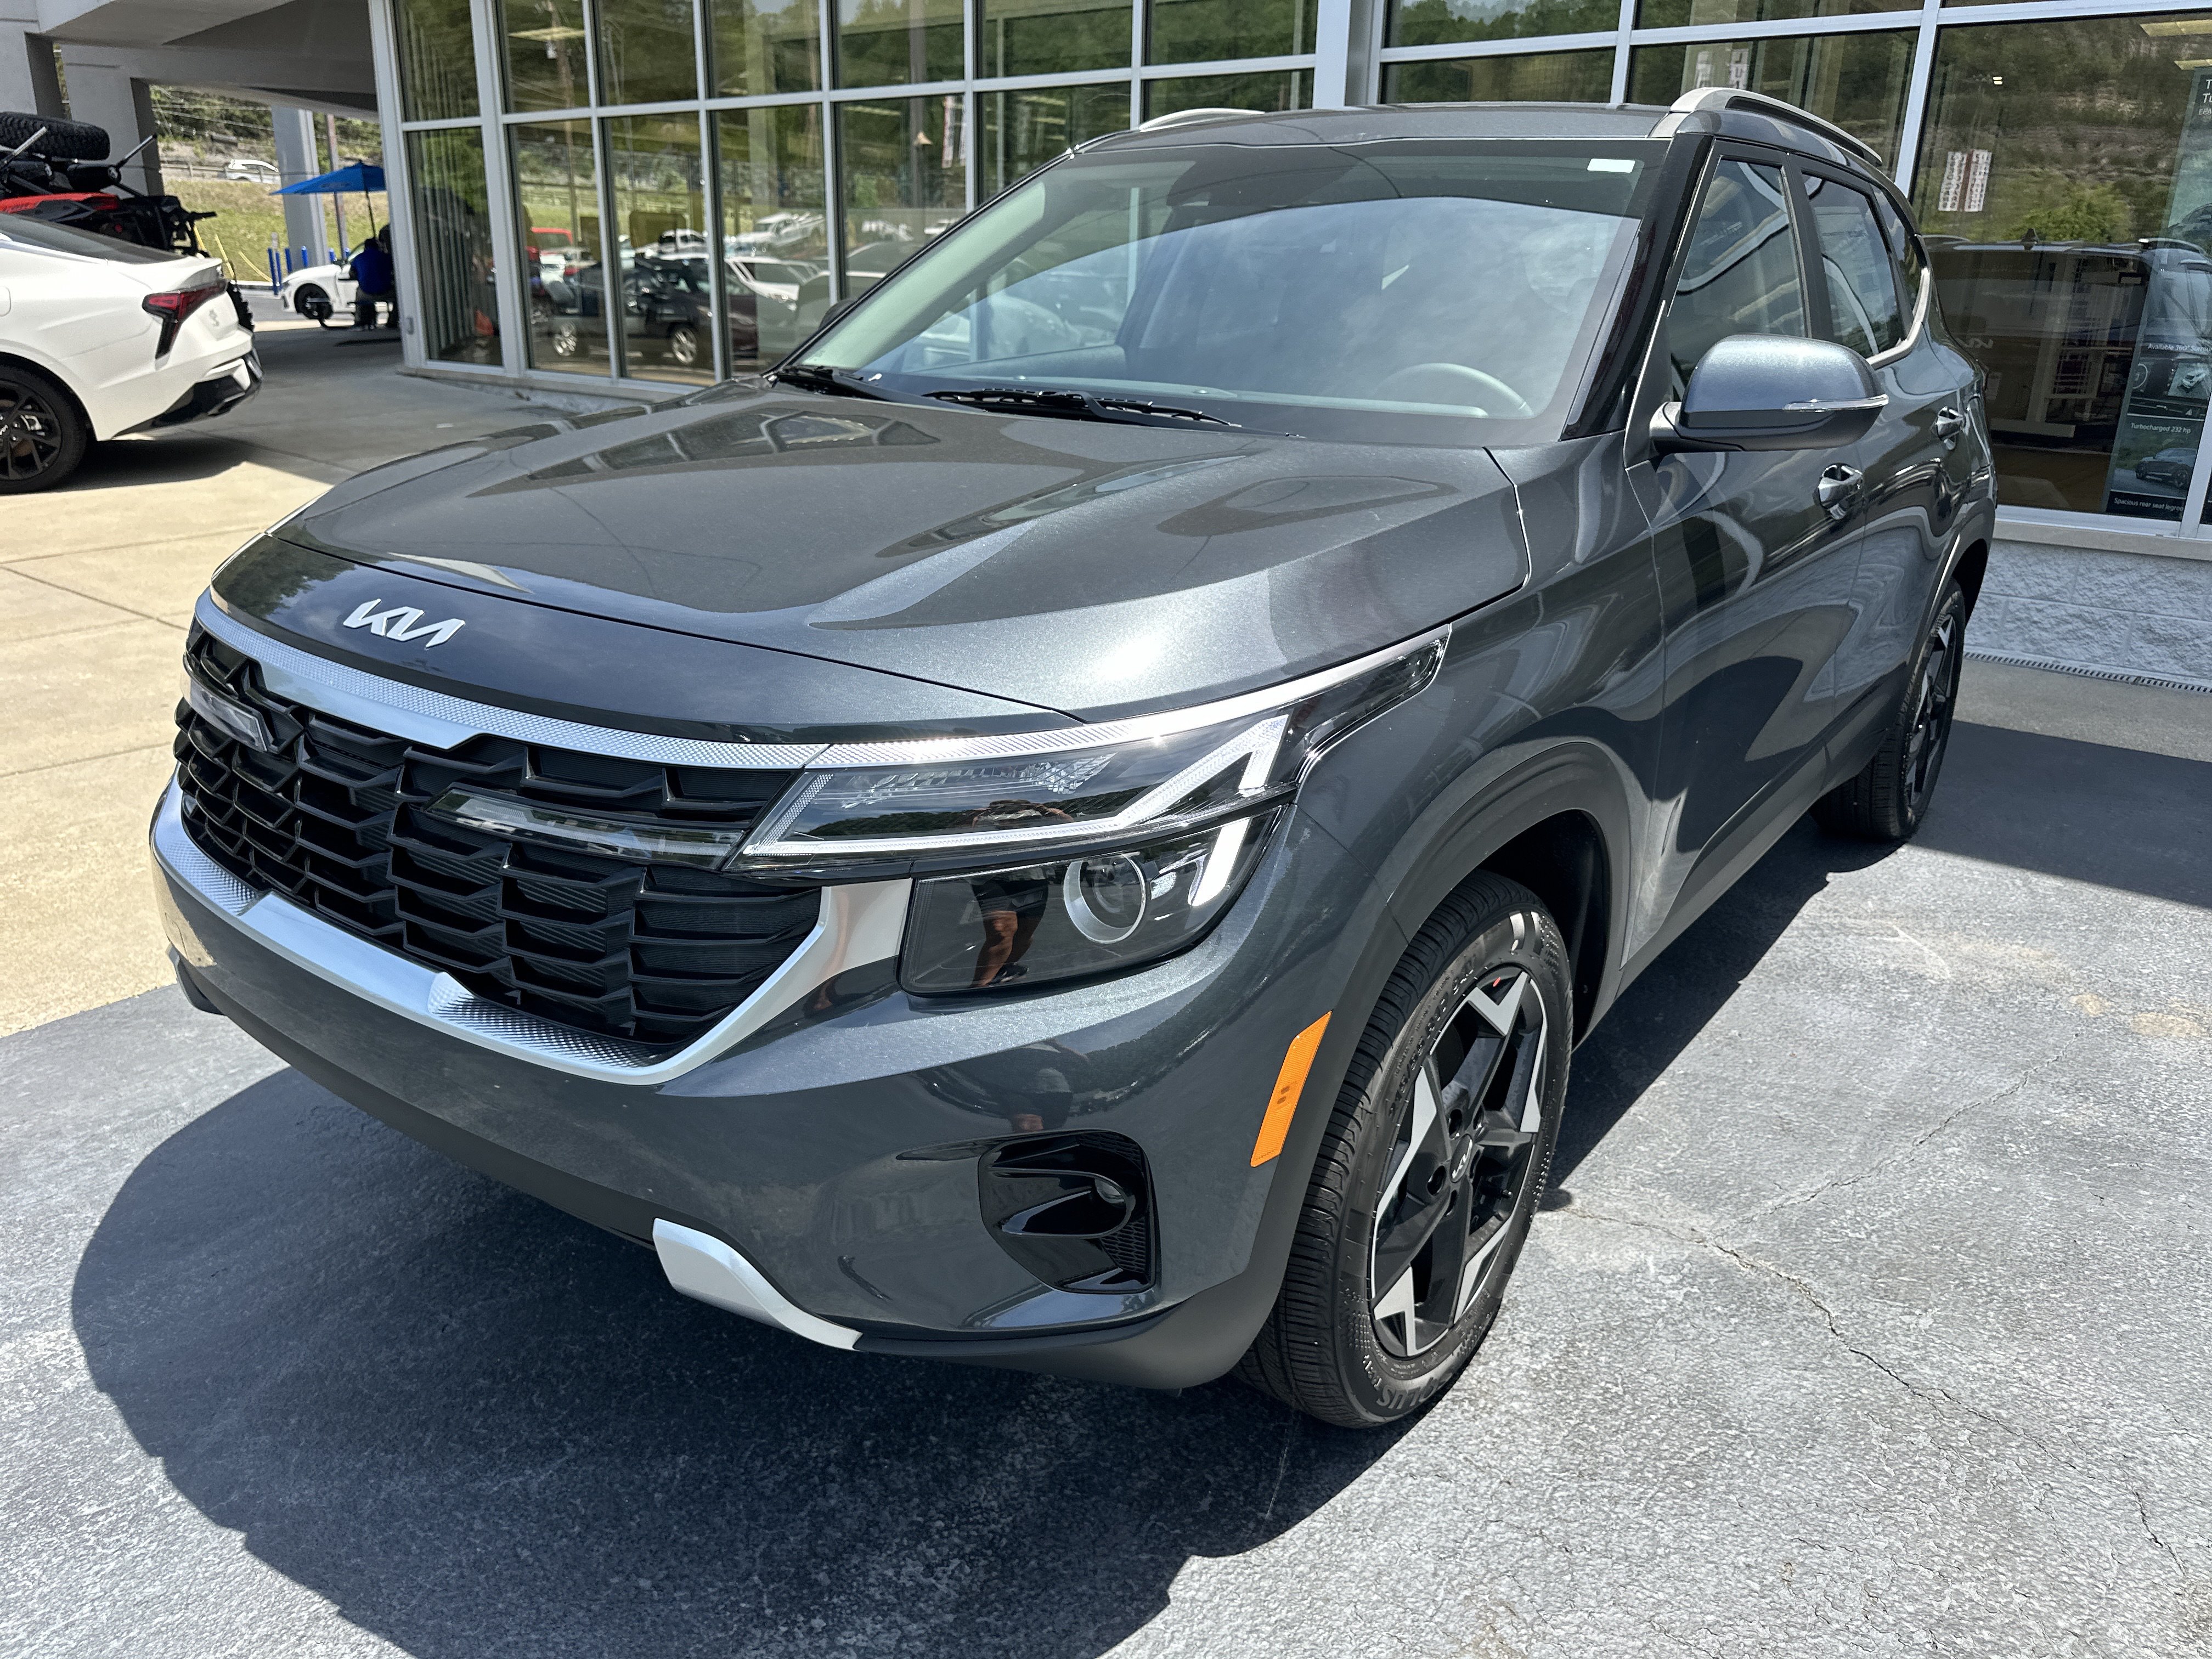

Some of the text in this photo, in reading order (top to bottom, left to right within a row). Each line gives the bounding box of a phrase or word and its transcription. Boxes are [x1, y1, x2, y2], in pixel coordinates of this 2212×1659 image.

[2131, 422, 2170, 432] Turbocharged
[2114, 497, 2138, 506] Spacious
[343, 598, 465, 648] KIA
[1452, 1139, 1472, 1178] KIA
